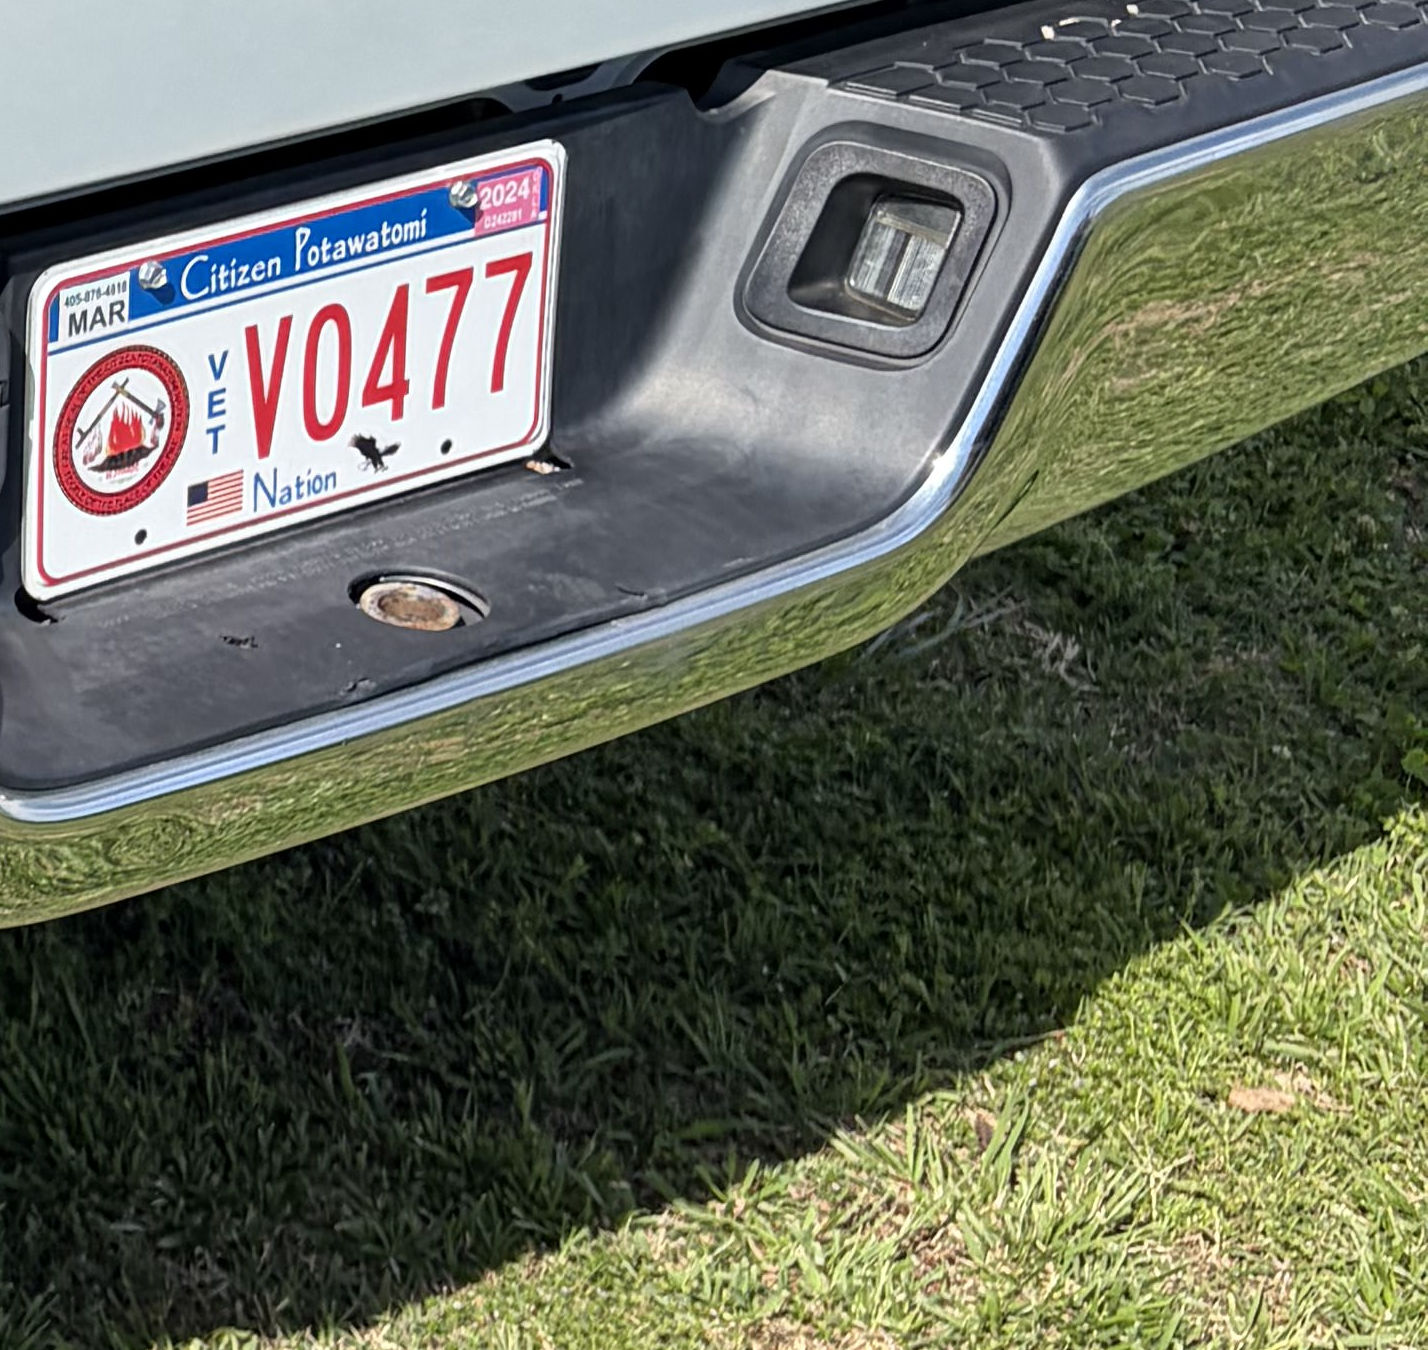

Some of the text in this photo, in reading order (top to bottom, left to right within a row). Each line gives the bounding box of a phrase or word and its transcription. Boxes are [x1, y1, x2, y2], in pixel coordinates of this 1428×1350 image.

[479, 177, 531, 211] 2024
[181, 208, 428, 300] Citizen Potawatomi
[68, 300, 126, 337] MAR
[206, 350, 230, 455] VET
[253, 466, 338, 514] Nation
